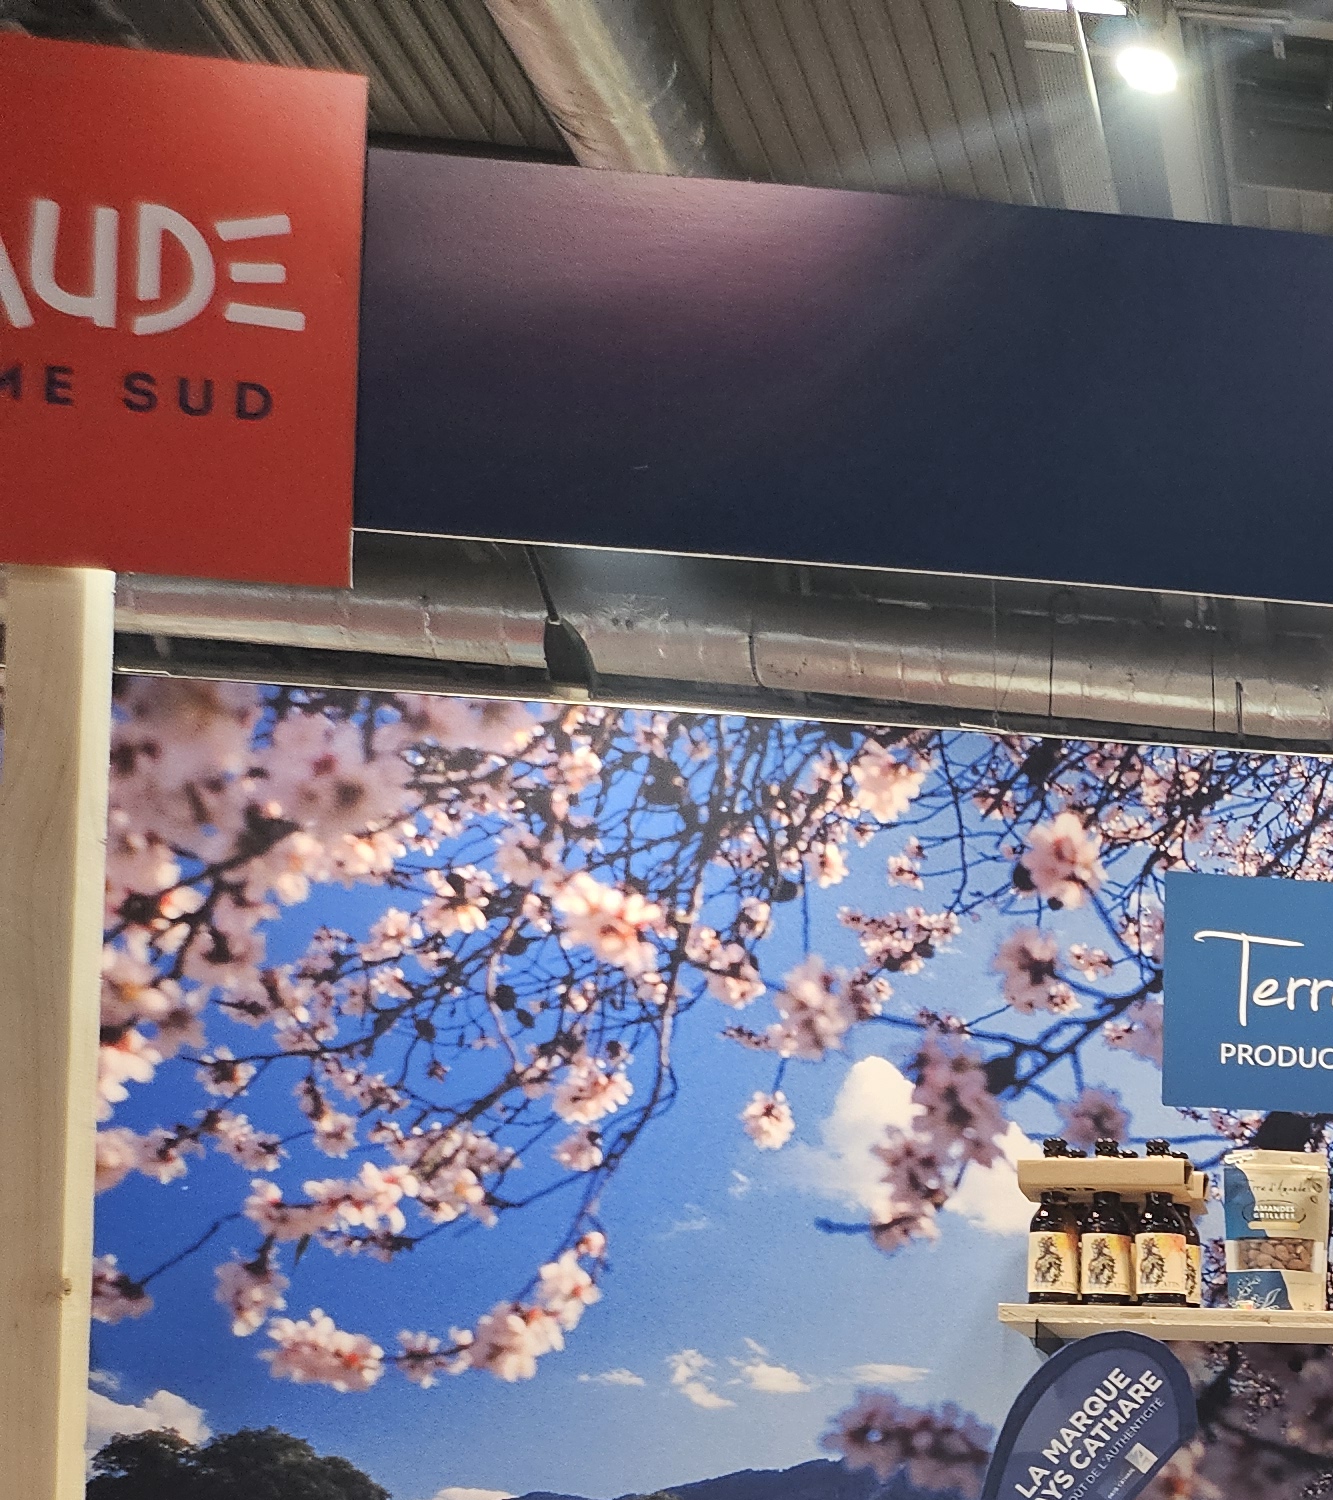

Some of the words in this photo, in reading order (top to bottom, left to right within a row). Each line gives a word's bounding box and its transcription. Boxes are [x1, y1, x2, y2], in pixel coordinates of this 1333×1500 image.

[122, 371, 274, 420] SUD
[1253, 1204, 1296, 1213] AMANDES
[1015, 1465, 1050, 1498] LA
[1041, 1367, 1132, 1465] MARQUE
[1069, 1369, 1163, 1470] CATHARE
[1086, 1467, 1102, 1485] DE
[1097, 1397, 1166, 1471] L'AUTHENTICITÉ
